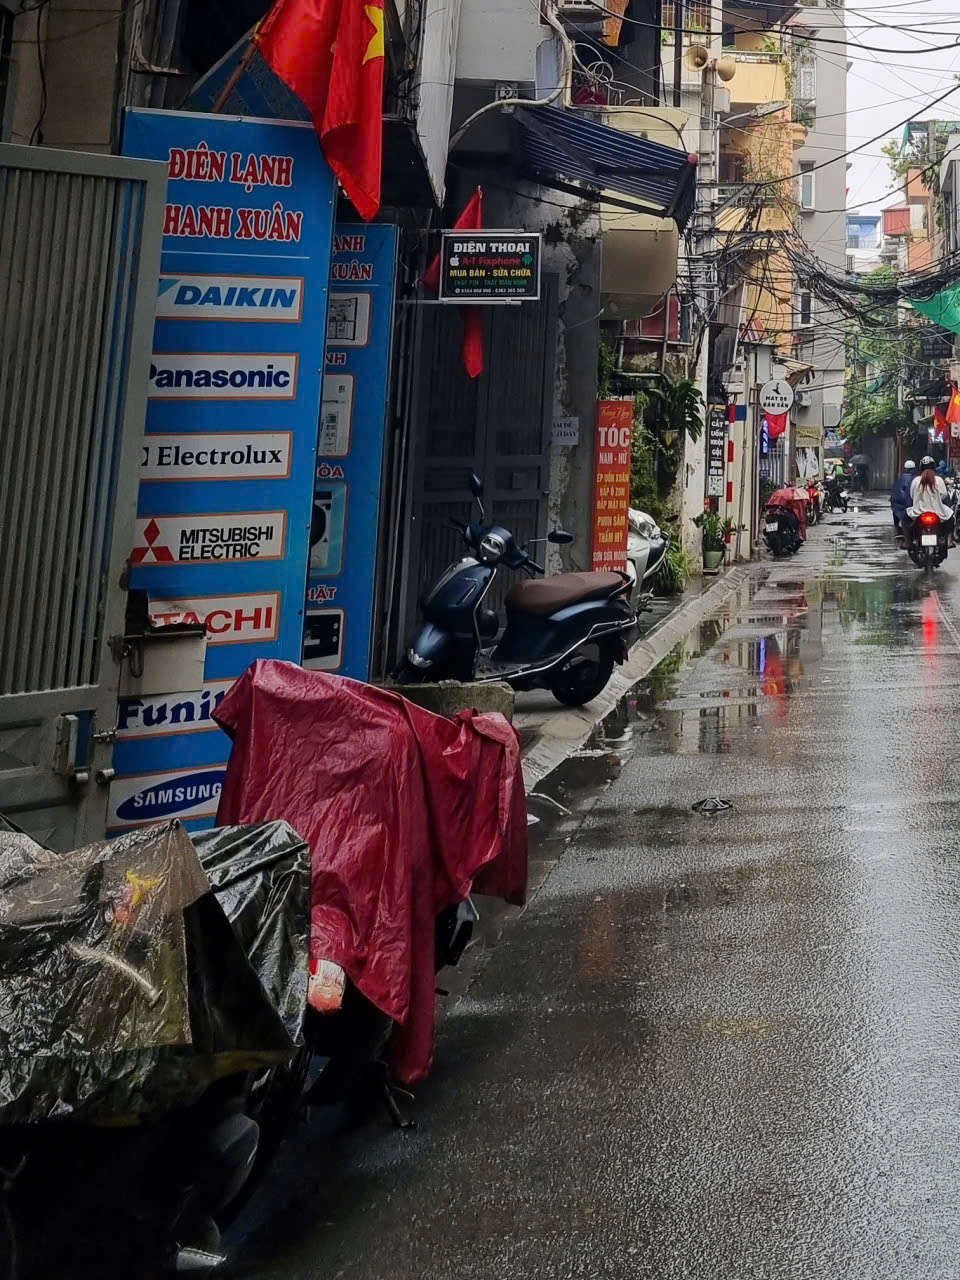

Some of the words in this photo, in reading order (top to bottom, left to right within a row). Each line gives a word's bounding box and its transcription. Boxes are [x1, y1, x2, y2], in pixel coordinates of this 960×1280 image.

[230, 152, 294, 193] LẠNH
[162, 203, 233, 239] HANH
[235, 200, 304, 242] XUÂN
[332, 234, 365, 256] ẠNH
[453, 240, 487, 255] ĐIỆN
[490, 242, 530, 254] THOẠI
[470, 267, 486, 277] BÁN
[493, 267, 508, 277] SỬA
[510, 268, 532, 277] CHỮA
[174, 285, 298, 308] DAIKIN
[598, 423, 631, 447] TÓC
[157, 444, 283, 466] Electrolux
[599, 452, 614, 464] NAM
[180, 525, 274, 545] MITSUBISHI
[178, 541, 261, 561] ELECTRIC
[133, 782, 222, 808] SAMSUNG
